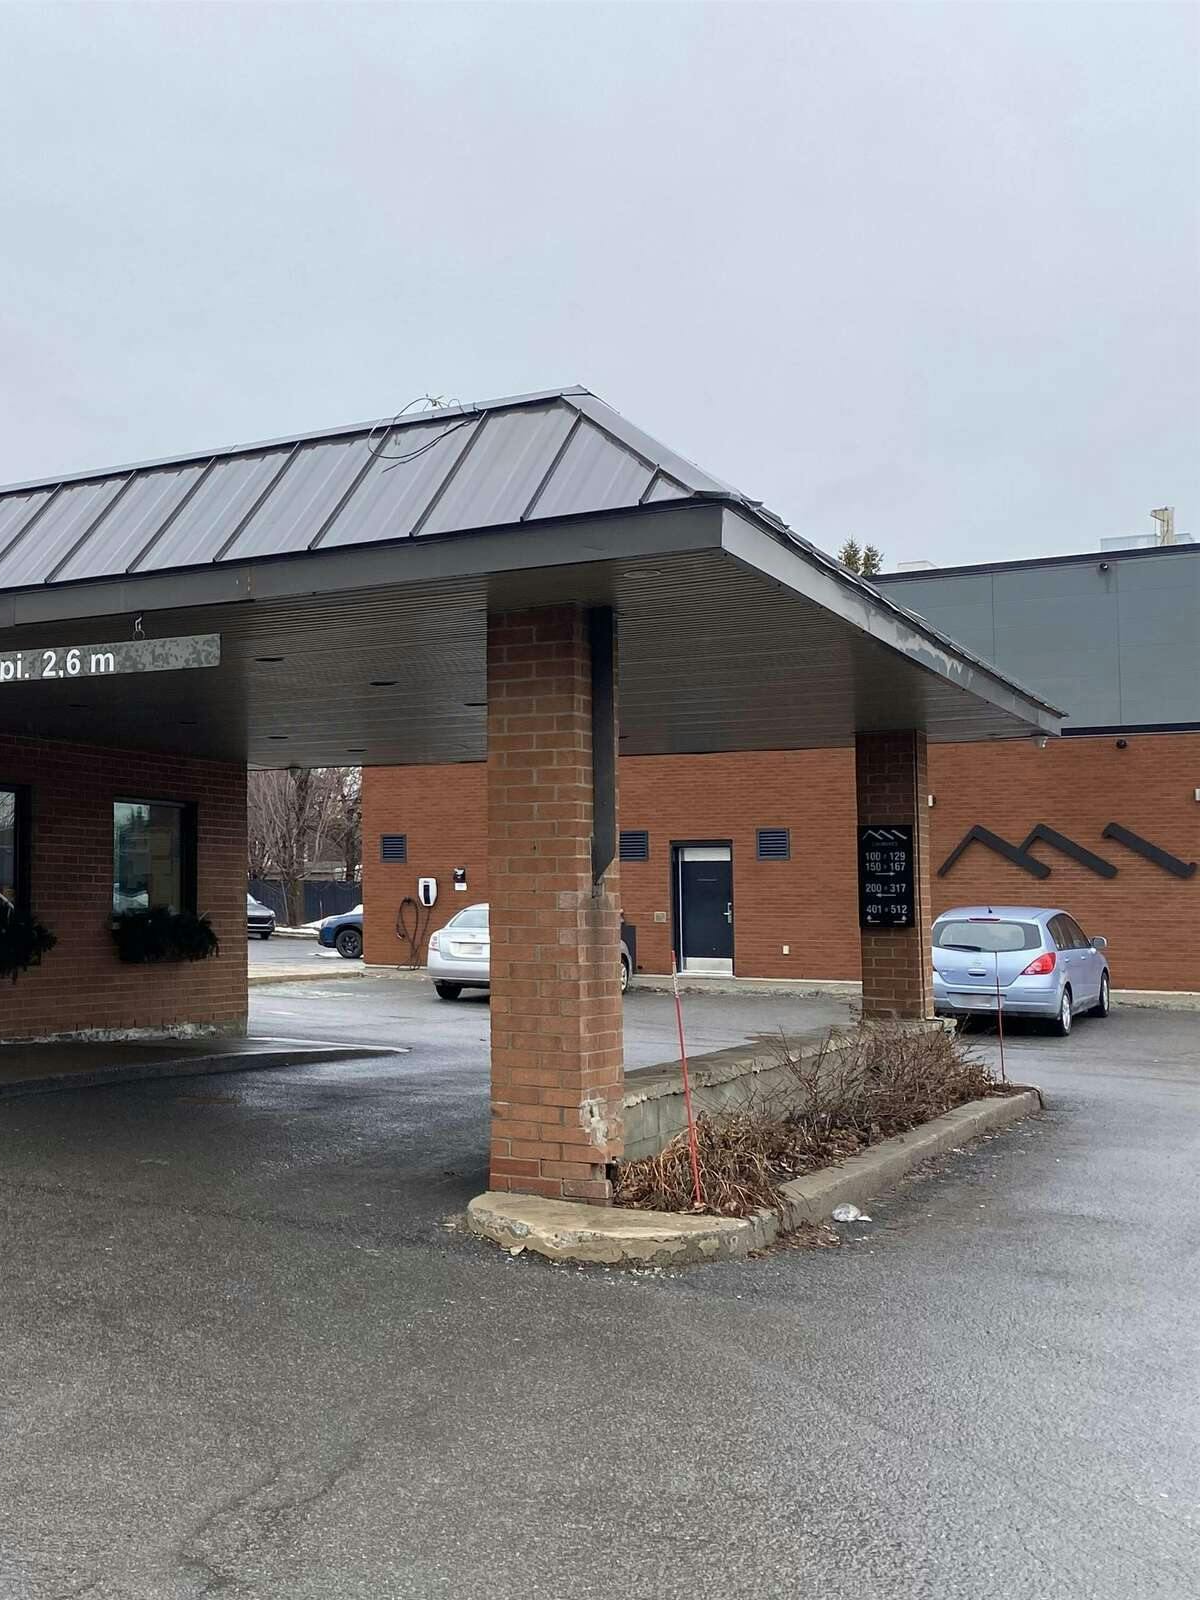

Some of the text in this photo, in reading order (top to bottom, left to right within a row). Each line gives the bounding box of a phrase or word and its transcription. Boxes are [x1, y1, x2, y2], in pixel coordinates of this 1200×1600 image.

[0, 653, 30, 681] pi.
[42, 648, 81, 678] 2,6
[90, 651, 115, 673] m
[865, 851, 881, 861] 100
[889, 851, 906, 861] 129
[865, 862, 882, 871] 150
[890, 862, 906, 871] 167
[865, 883, 882, 893] 200
[889, 883, 906, 893] 317
[866, 904, 882, 914] 401
[890, 904, 908, 914] 512
